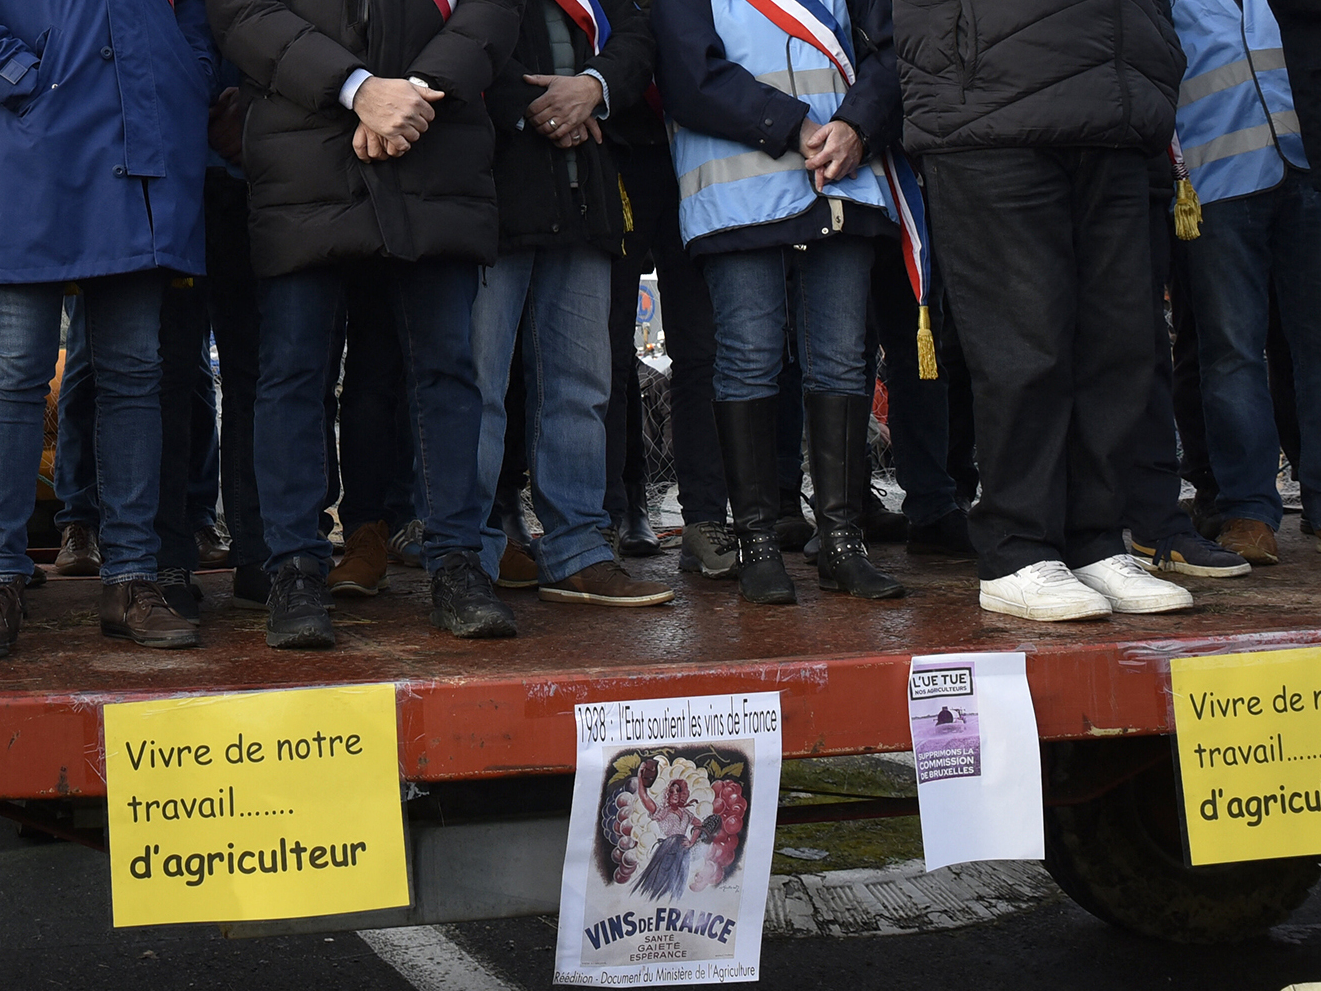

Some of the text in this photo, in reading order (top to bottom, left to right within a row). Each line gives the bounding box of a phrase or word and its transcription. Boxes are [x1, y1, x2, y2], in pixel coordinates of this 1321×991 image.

[913, 674, 966, 688] L'UE TUE
[927, 686, 967, 694] AGRICULTEURS
[1190, 692, 1263, 720] Vivre
[1273, 685, 1304, 713] de
[578, 706, 606, 743] 1938
[618, 702, 644, 741] l'Etat
[648, 707, 685, 740] soutient
[688, 700, 702, 737] les
[704, 704, 723, 736] vins
[727, 696, 740, 735] de
[743, 699, 777, 734] France
[125, 731, 363, 771] Vivre de notre
[918, 749, 961, 760] SUPPRIMONS
[920, 756, 974, 770] COMMISSION
[921, 767, 974, 780] DE BRUXELLES
[130, 837, 367, 886] d'agriculteur
[584, 908, 736, 950] VINS DE FRANCE
[600, 972, 641, 984] Document
[643, 970, 653, 982] du
[656, 967, 692, 982] Ministère
[695, 964, 706, 978] de
[708, 962, 755, 983] l'Agriculture
